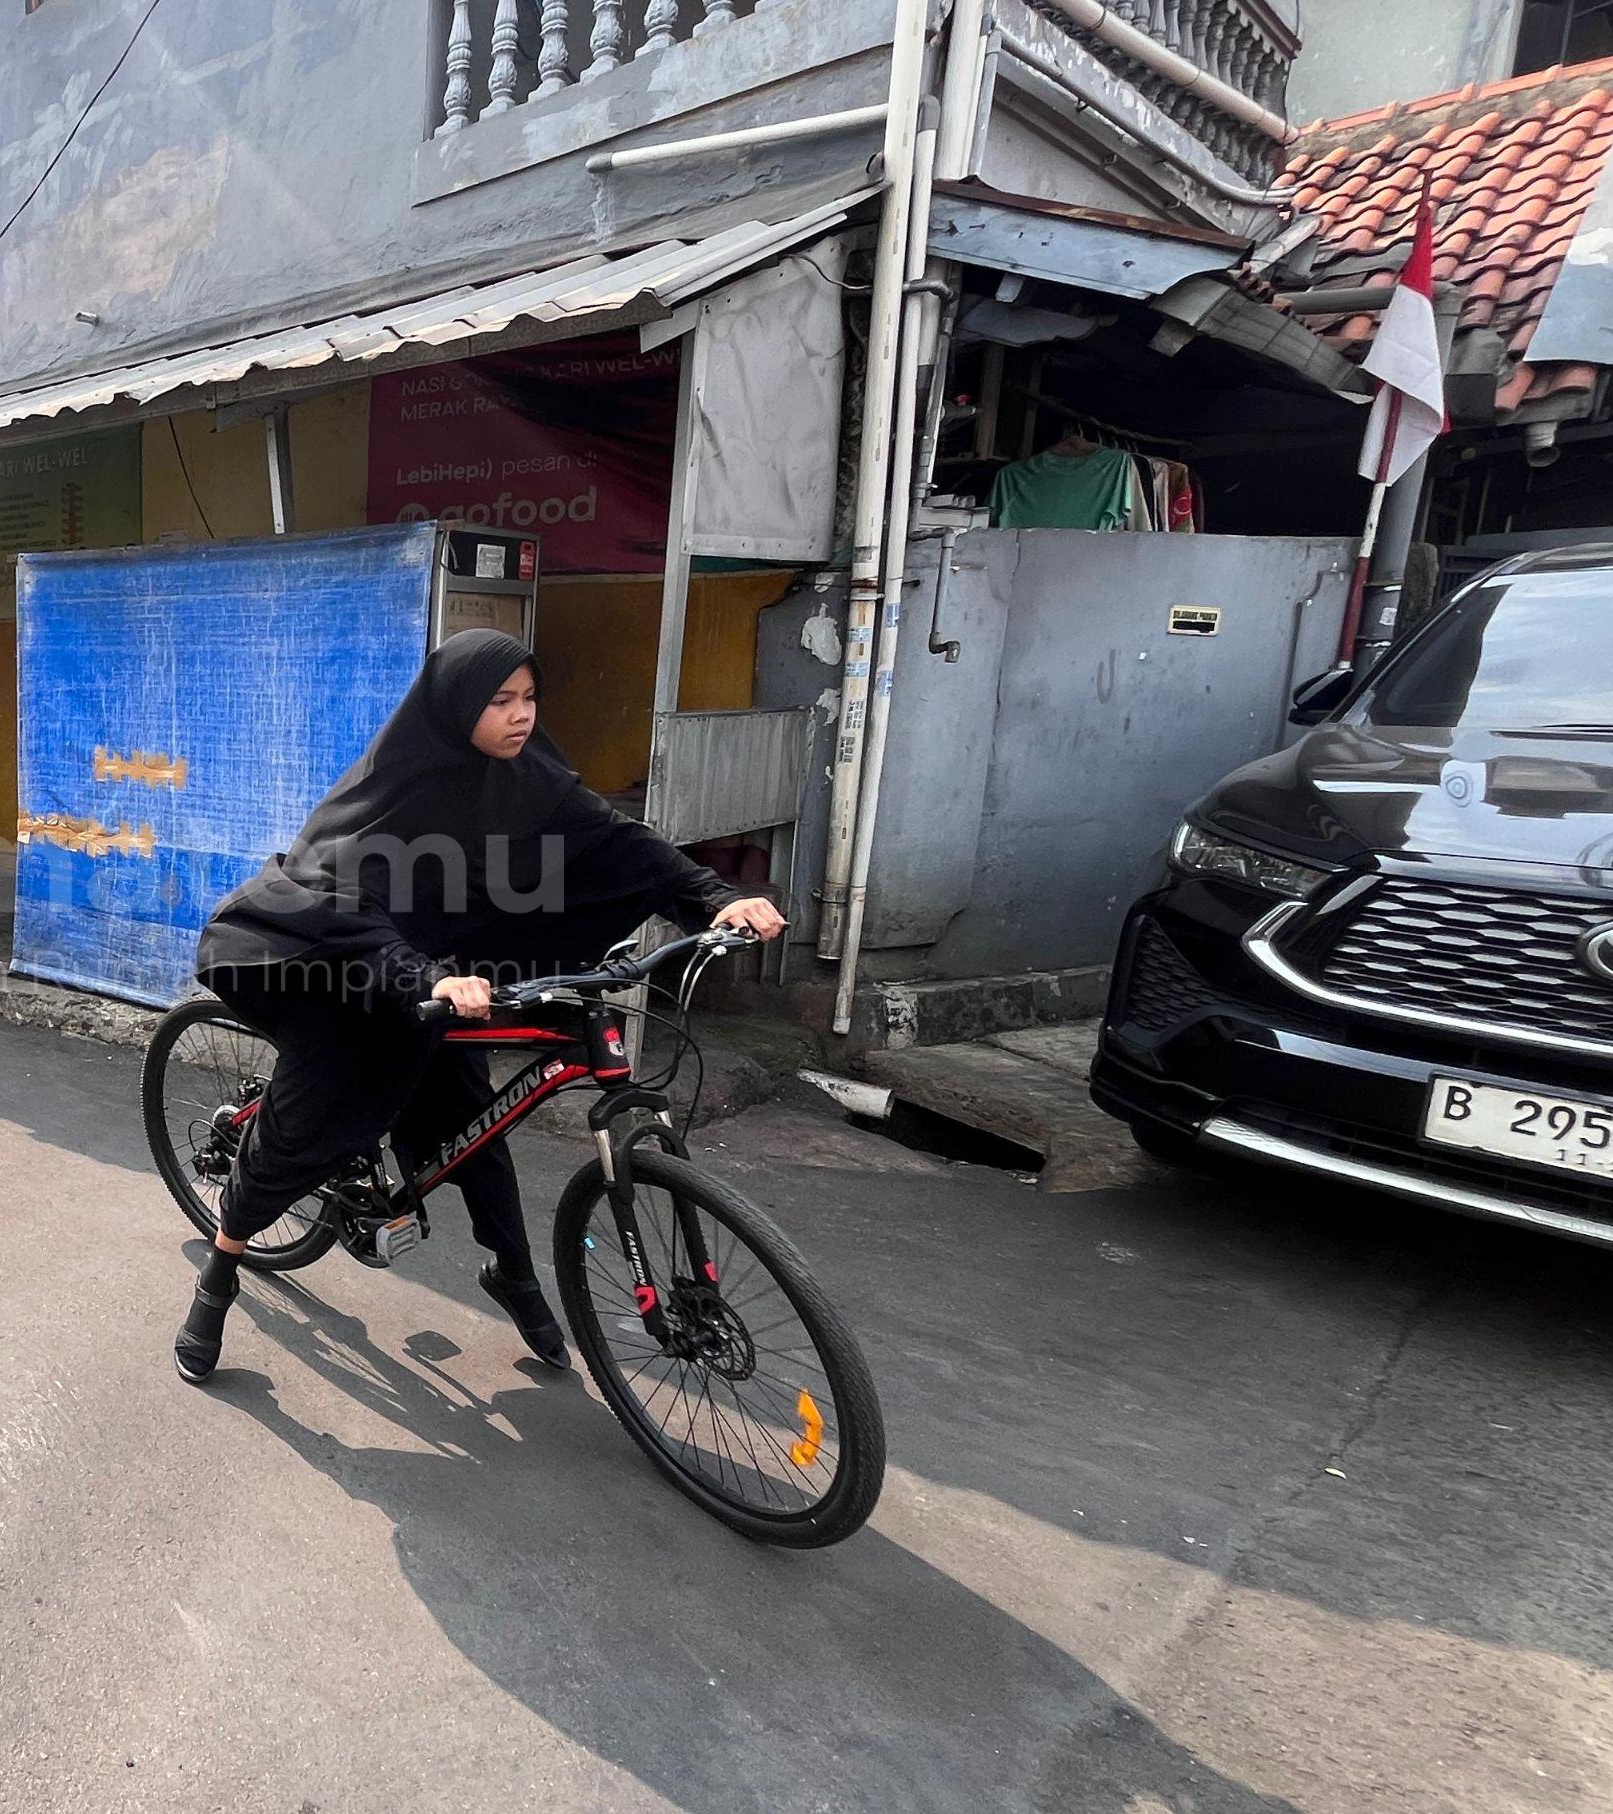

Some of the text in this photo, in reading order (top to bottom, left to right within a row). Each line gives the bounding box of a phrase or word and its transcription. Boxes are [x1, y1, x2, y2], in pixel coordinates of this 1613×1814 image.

[401, 375, 446, 397] NASI
[595, 347, 680, 375] WEL-W
[401, 399, 468, 422] MERAK
[396, 457, 493, 486] LebiHepi)
[502, 453, 571, 481] pesan
[440, 1065, 541, 1167] FASTRON
[1443, 1085, 1613, 1150] B 295
